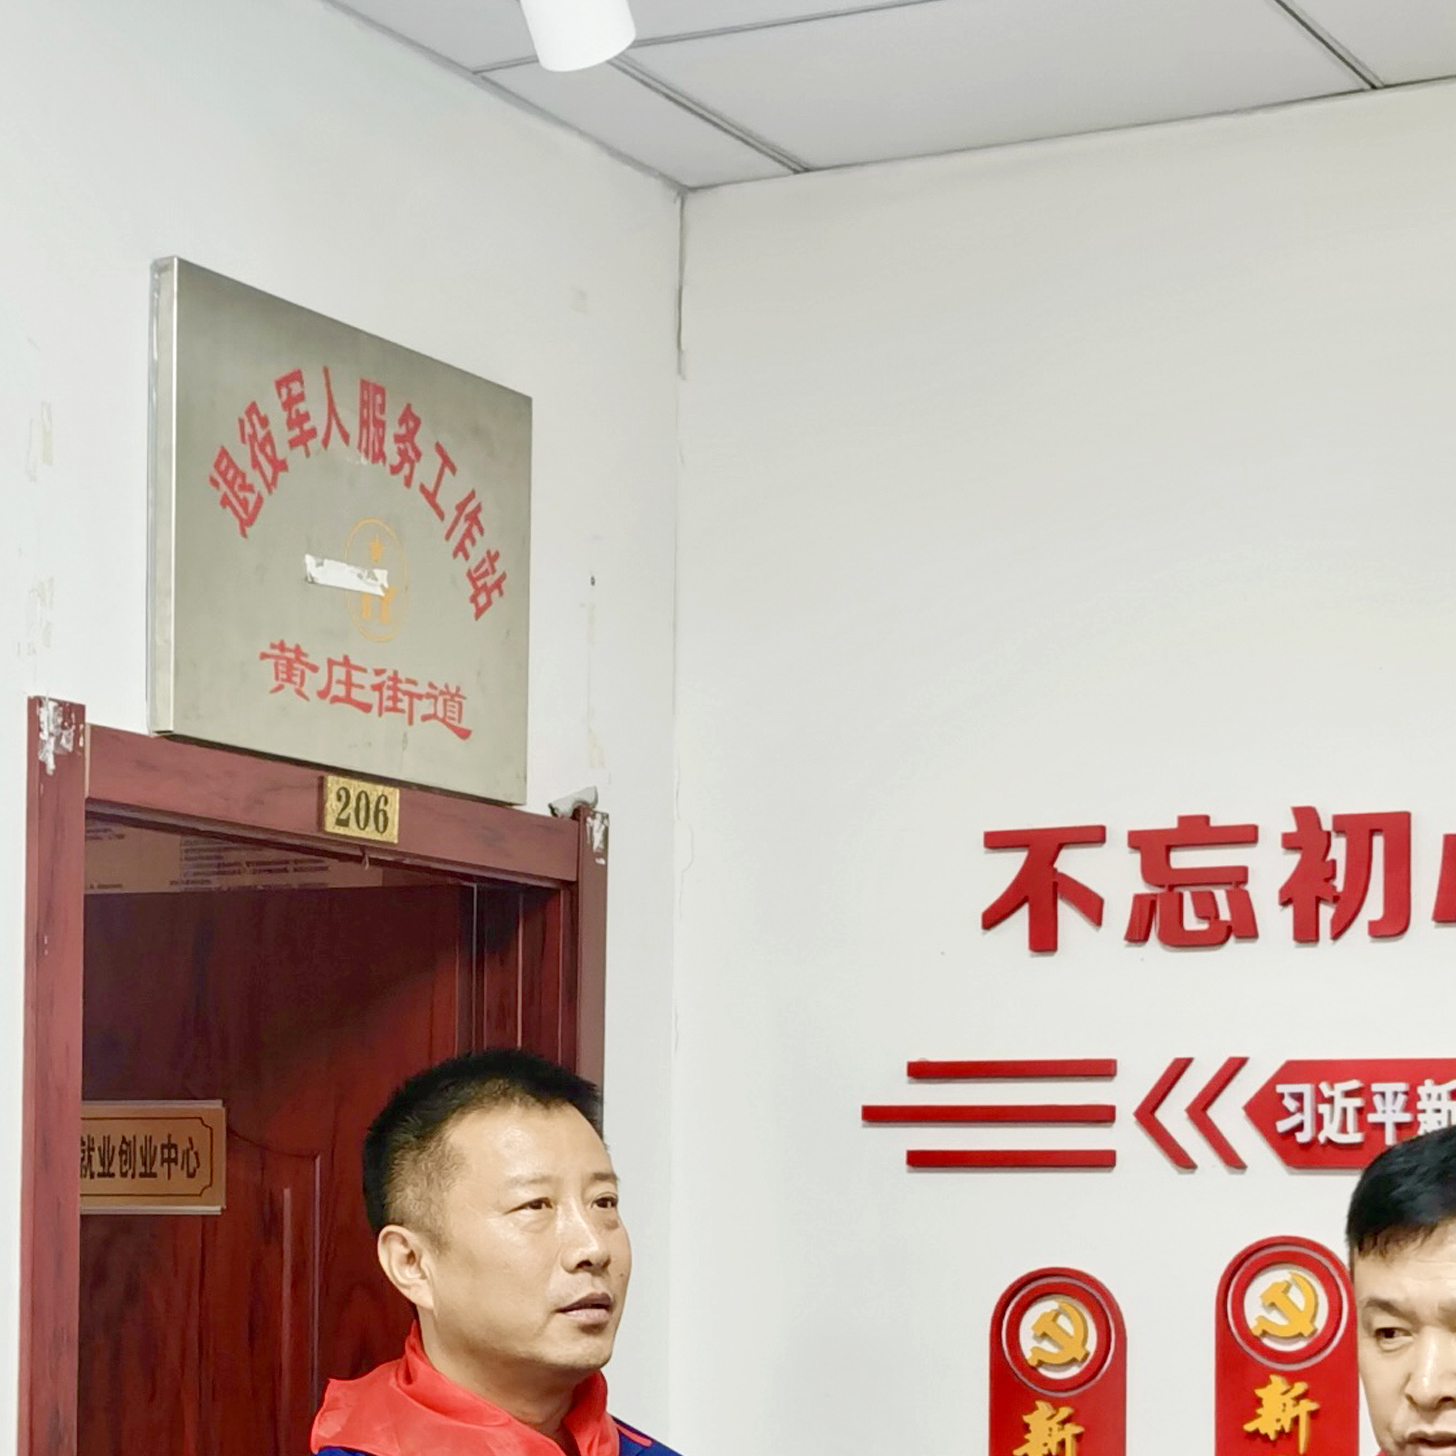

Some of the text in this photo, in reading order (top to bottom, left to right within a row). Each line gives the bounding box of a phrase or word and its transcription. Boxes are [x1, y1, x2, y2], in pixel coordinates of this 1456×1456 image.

[208, 366, 509, 620] 退役军人服务工作站
[259, 639, 472, 740] 黄庄街道
[335, 786, 389, 834] 206
[81, 1133, 201, 1181] 就业创业中心
